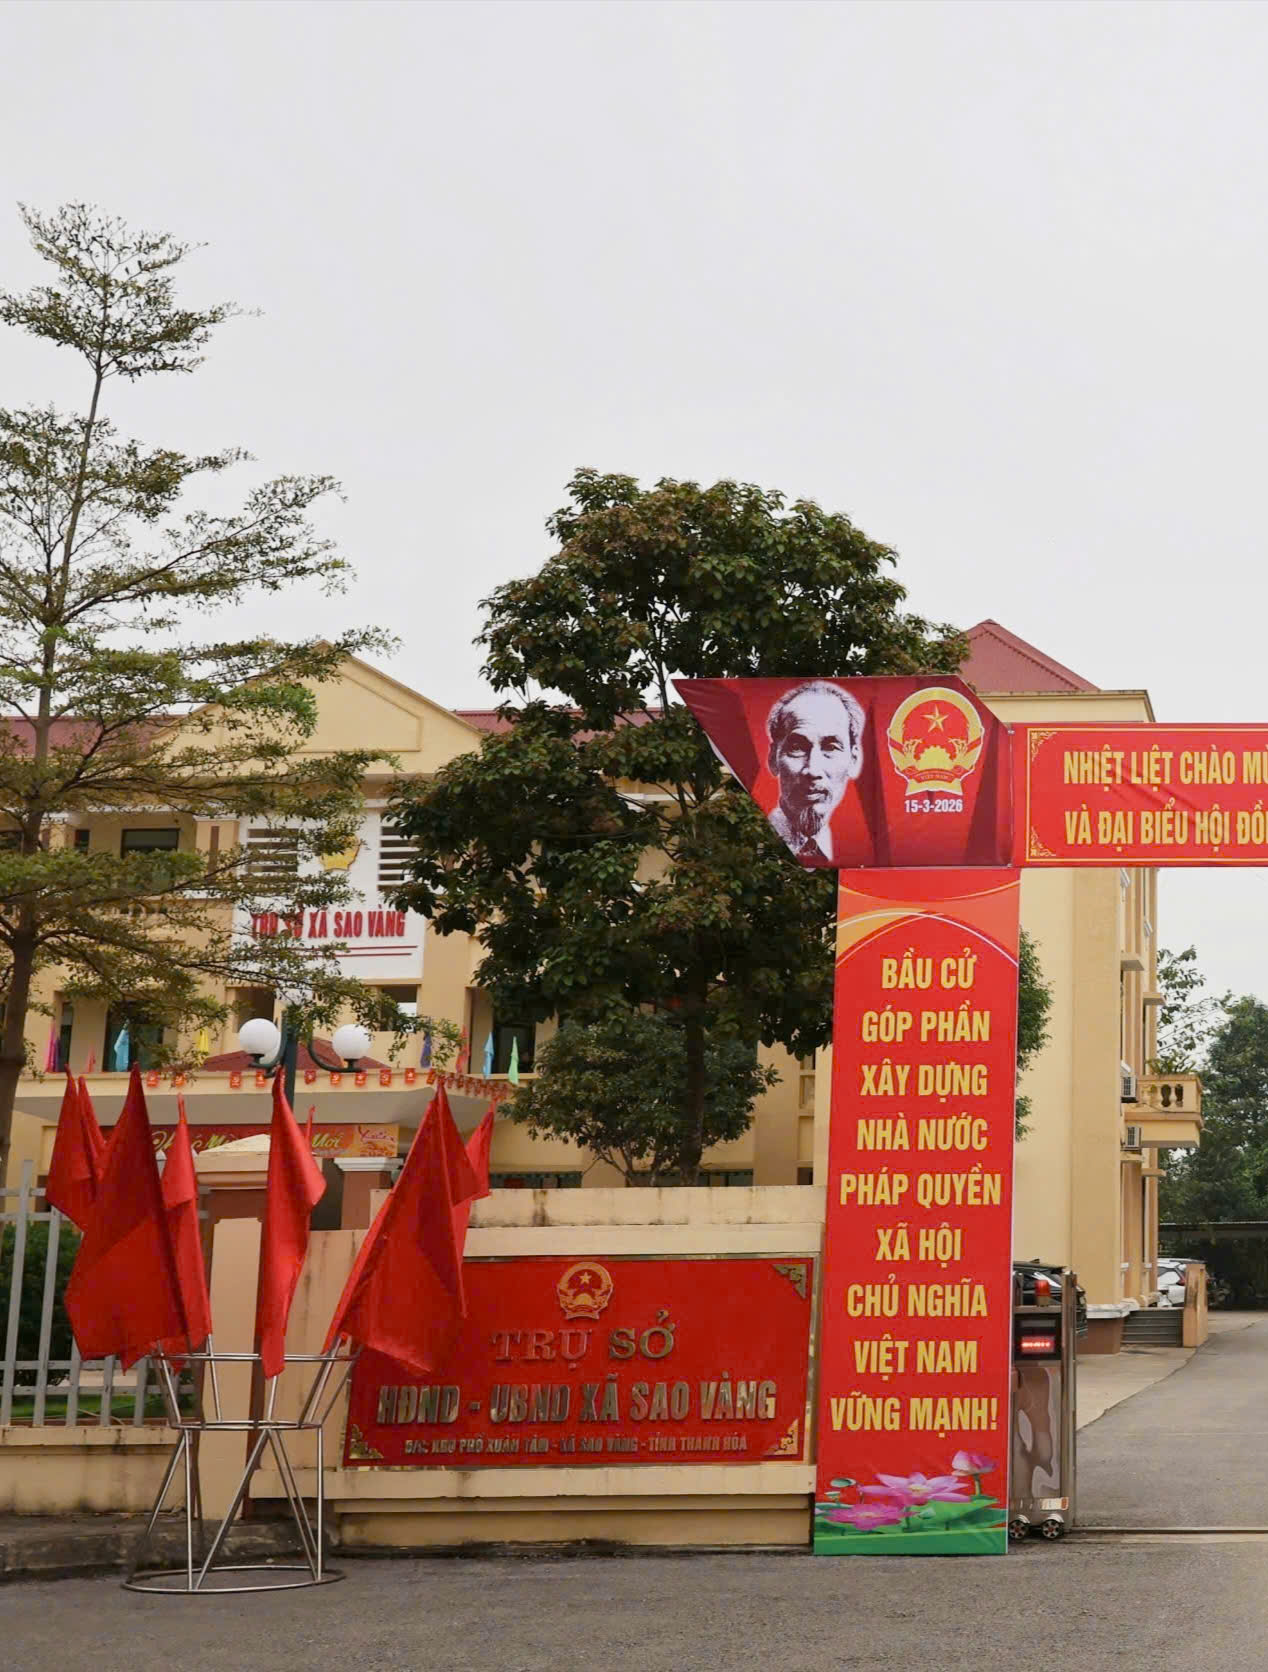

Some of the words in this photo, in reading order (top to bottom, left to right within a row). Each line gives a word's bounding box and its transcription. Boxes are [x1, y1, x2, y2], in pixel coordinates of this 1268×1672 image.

[1063, 744, 1125, 791] NHIỆT
[1131, 744, 1173, 791] LIỆT
[1180, 744, 1236, 784] CHÀO
[905, 799, 963, 813] 15-3-2026
[1064, 804, 1092, 844] VÀ
[1098, 811, 1134, 852] ĐẠI
[1140, 797, 1188, 844] BIỂU
[1195, 804, 1230, 852] HỘI
[333, 910, 363, 938] SAO
[367, 904, 406, 937] VÀNG
[881, 947, 932, 989] BẦU
[940, 947, 977, 989] CỬ
[861, 1005, 913, 1042] GÓP
[920, 1000, 990, 1042] PHẦN
[860, 1058, 910, 1096] XÂY
[918, 1061, 987, 1102] DỰNG
[856, 1112, 909, 1150] NHÀ
[918, 1112, 988, 1150] NƯỚC
[840, 1167, 909, 1205] PHÁP
[917, 1163, 1001, 1208] QUYỀN
[875, 1222, 910, 1260] XÃ
[919, 1222, 962, 1268] HỘI
[847, 1273, 899, 1317] CHỦ
[908, 1278, 988, 1317] NGHĨA
[490, 1328, 592, 1371] TRỤ
[608, 1309, 677, 1359] SỞ
[854, 1333, 909, 1381] VIỆT
[917, 1340, 978, 1374] NAM
[377, 1384, 460, 1424] HĐND
[489, 1384, 570, 1424] UBND
[579, 1373, 620, 1422] XÃ
[629, 1380, 690, 1422] SAO
[700, 1370, 777, 1421] VÀNG
[830, 1391, 900, 1431] VỮNG
[909, 1397, 998, 1438] MẠNH!
[680, 1436, 720, 1451] THANH
